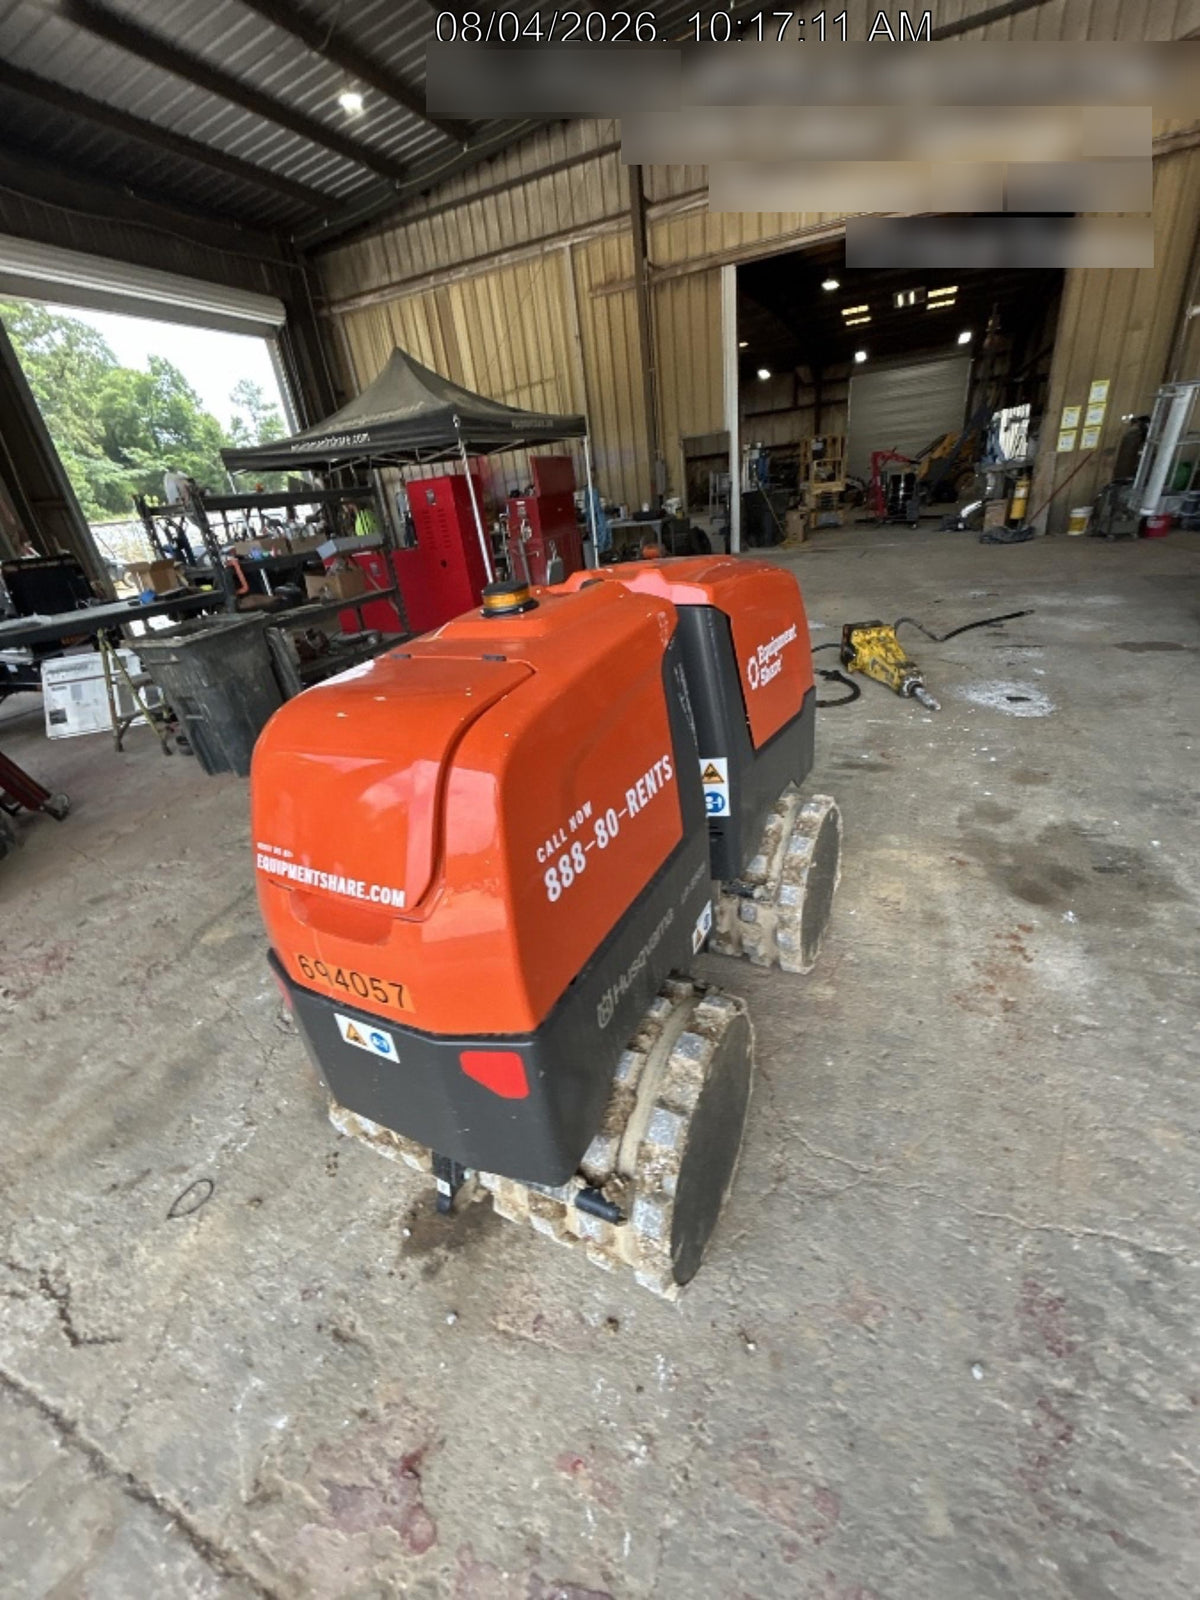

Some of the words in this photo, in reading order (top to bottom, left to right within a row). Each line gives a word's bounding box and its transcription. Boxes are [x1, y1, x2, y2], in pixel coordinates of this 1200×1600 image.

[536, 827, 568, 863] CALL
[568, 800, 593, 832] NOW
[544, 754, 673, 903] 888-80-RENTS
[256, 853, 406, 908] EQUIPMENTSHARE.COM
[297, 953, 404, 1009] 694057
